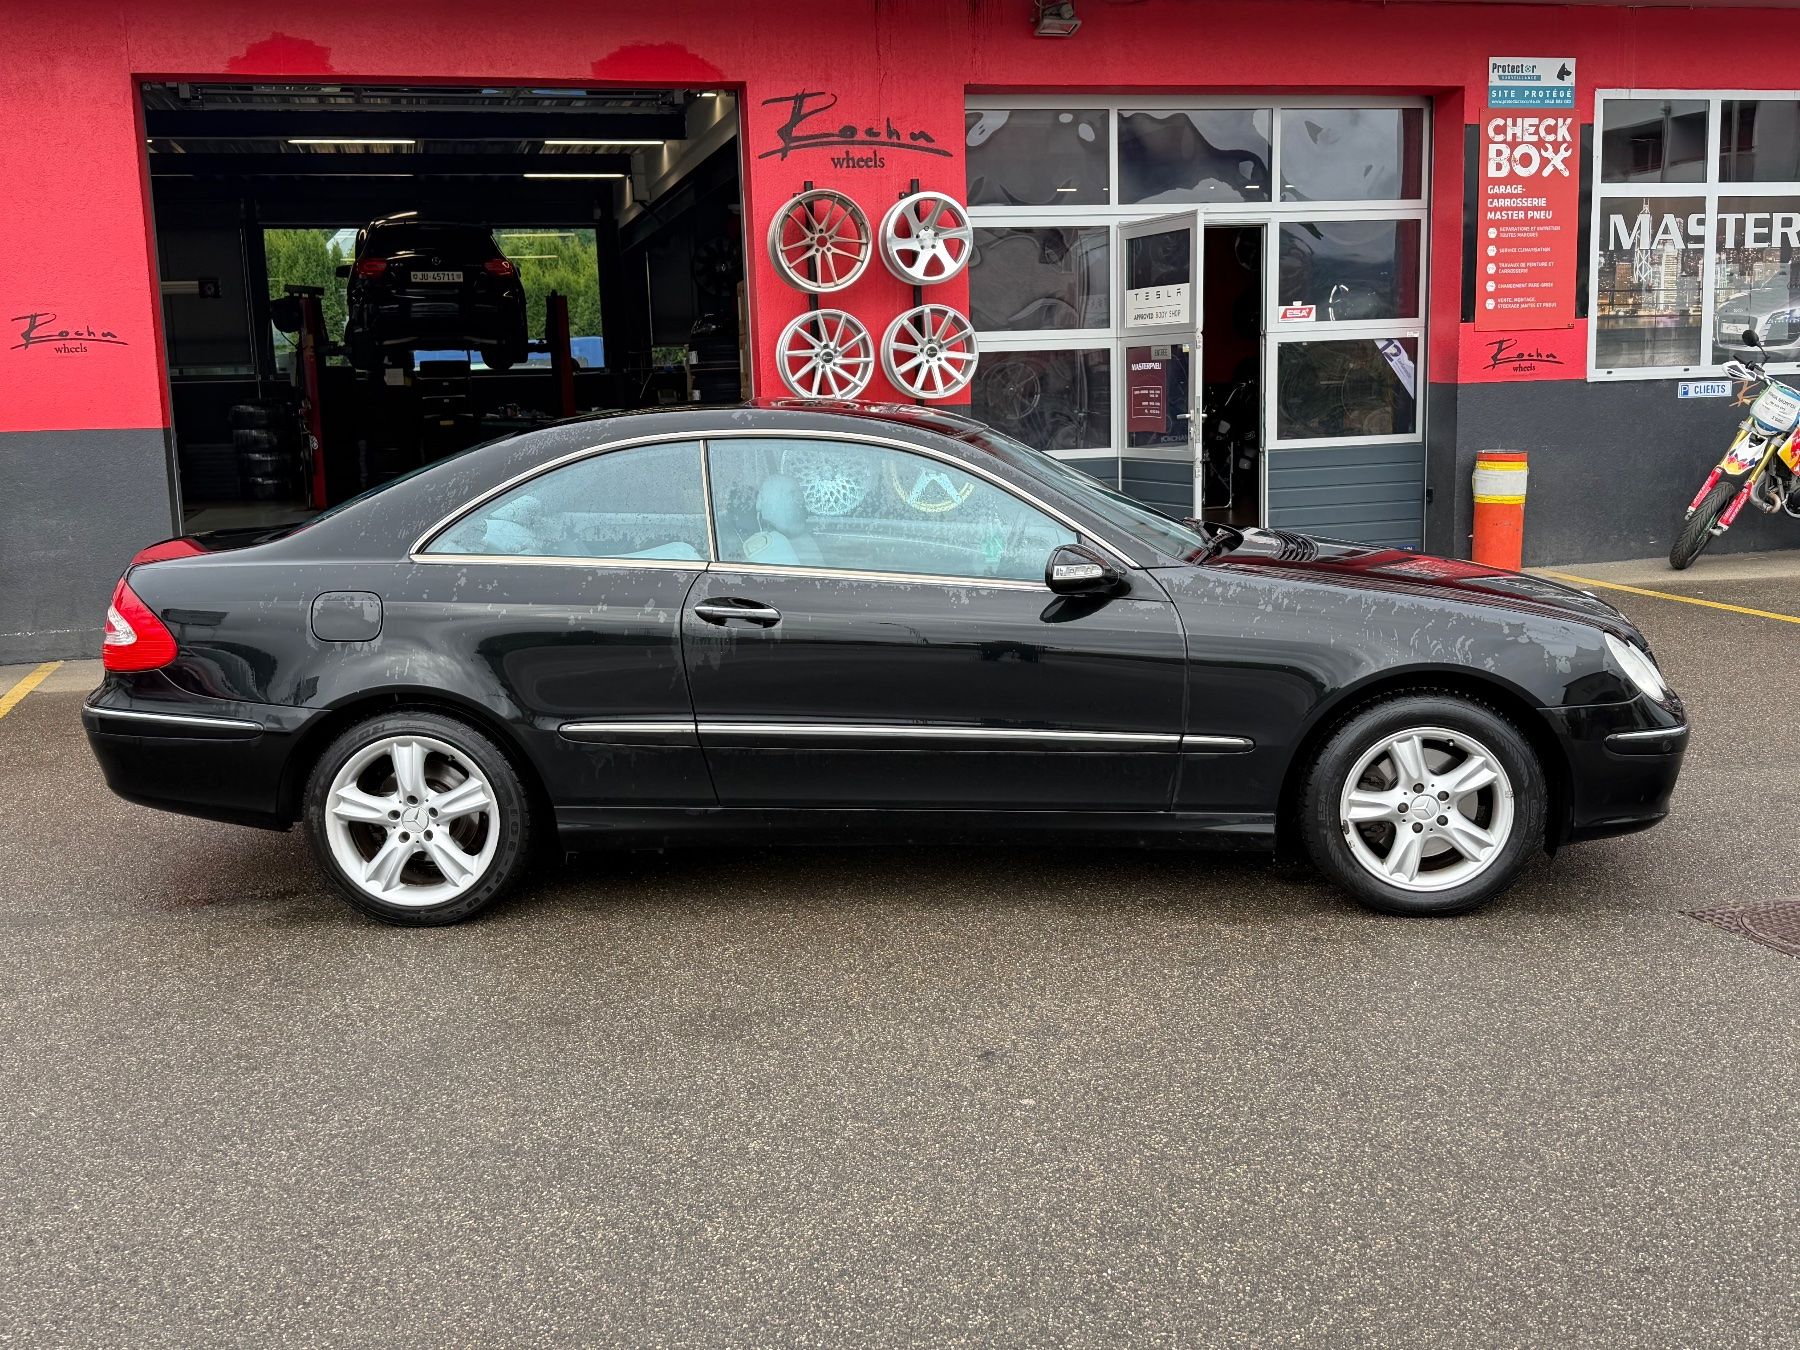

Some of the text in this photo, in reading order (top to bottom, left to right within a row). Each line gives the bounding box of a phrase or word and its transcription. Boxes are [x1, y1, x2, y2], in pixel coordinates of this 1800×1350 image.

[1491, 88, 1572, 98] SITE PROTÉGÉ
[1487, 117, 1573, 142] CHECK
[830, 150, 886, 170] wheels
[1487, 143, 1573, 178] BOX
[1487, 185, 1526, 194] GARAGE-
[1487, 198, 1547, 208] CARROSSERIE
[1487, 210, 1553, 220] MASTER PNEU
[1608, 212, 1800, 251] MASTER
[1134, 287, 1182, 302] TESLA
[1133, 309, 1182, 321] APPROVED BODY SHOP
[54, 343, 88, 354] wheels
[1512, 363, 1536, 373] wheels
[1694, 384, 1726, 395] CLIENTS
